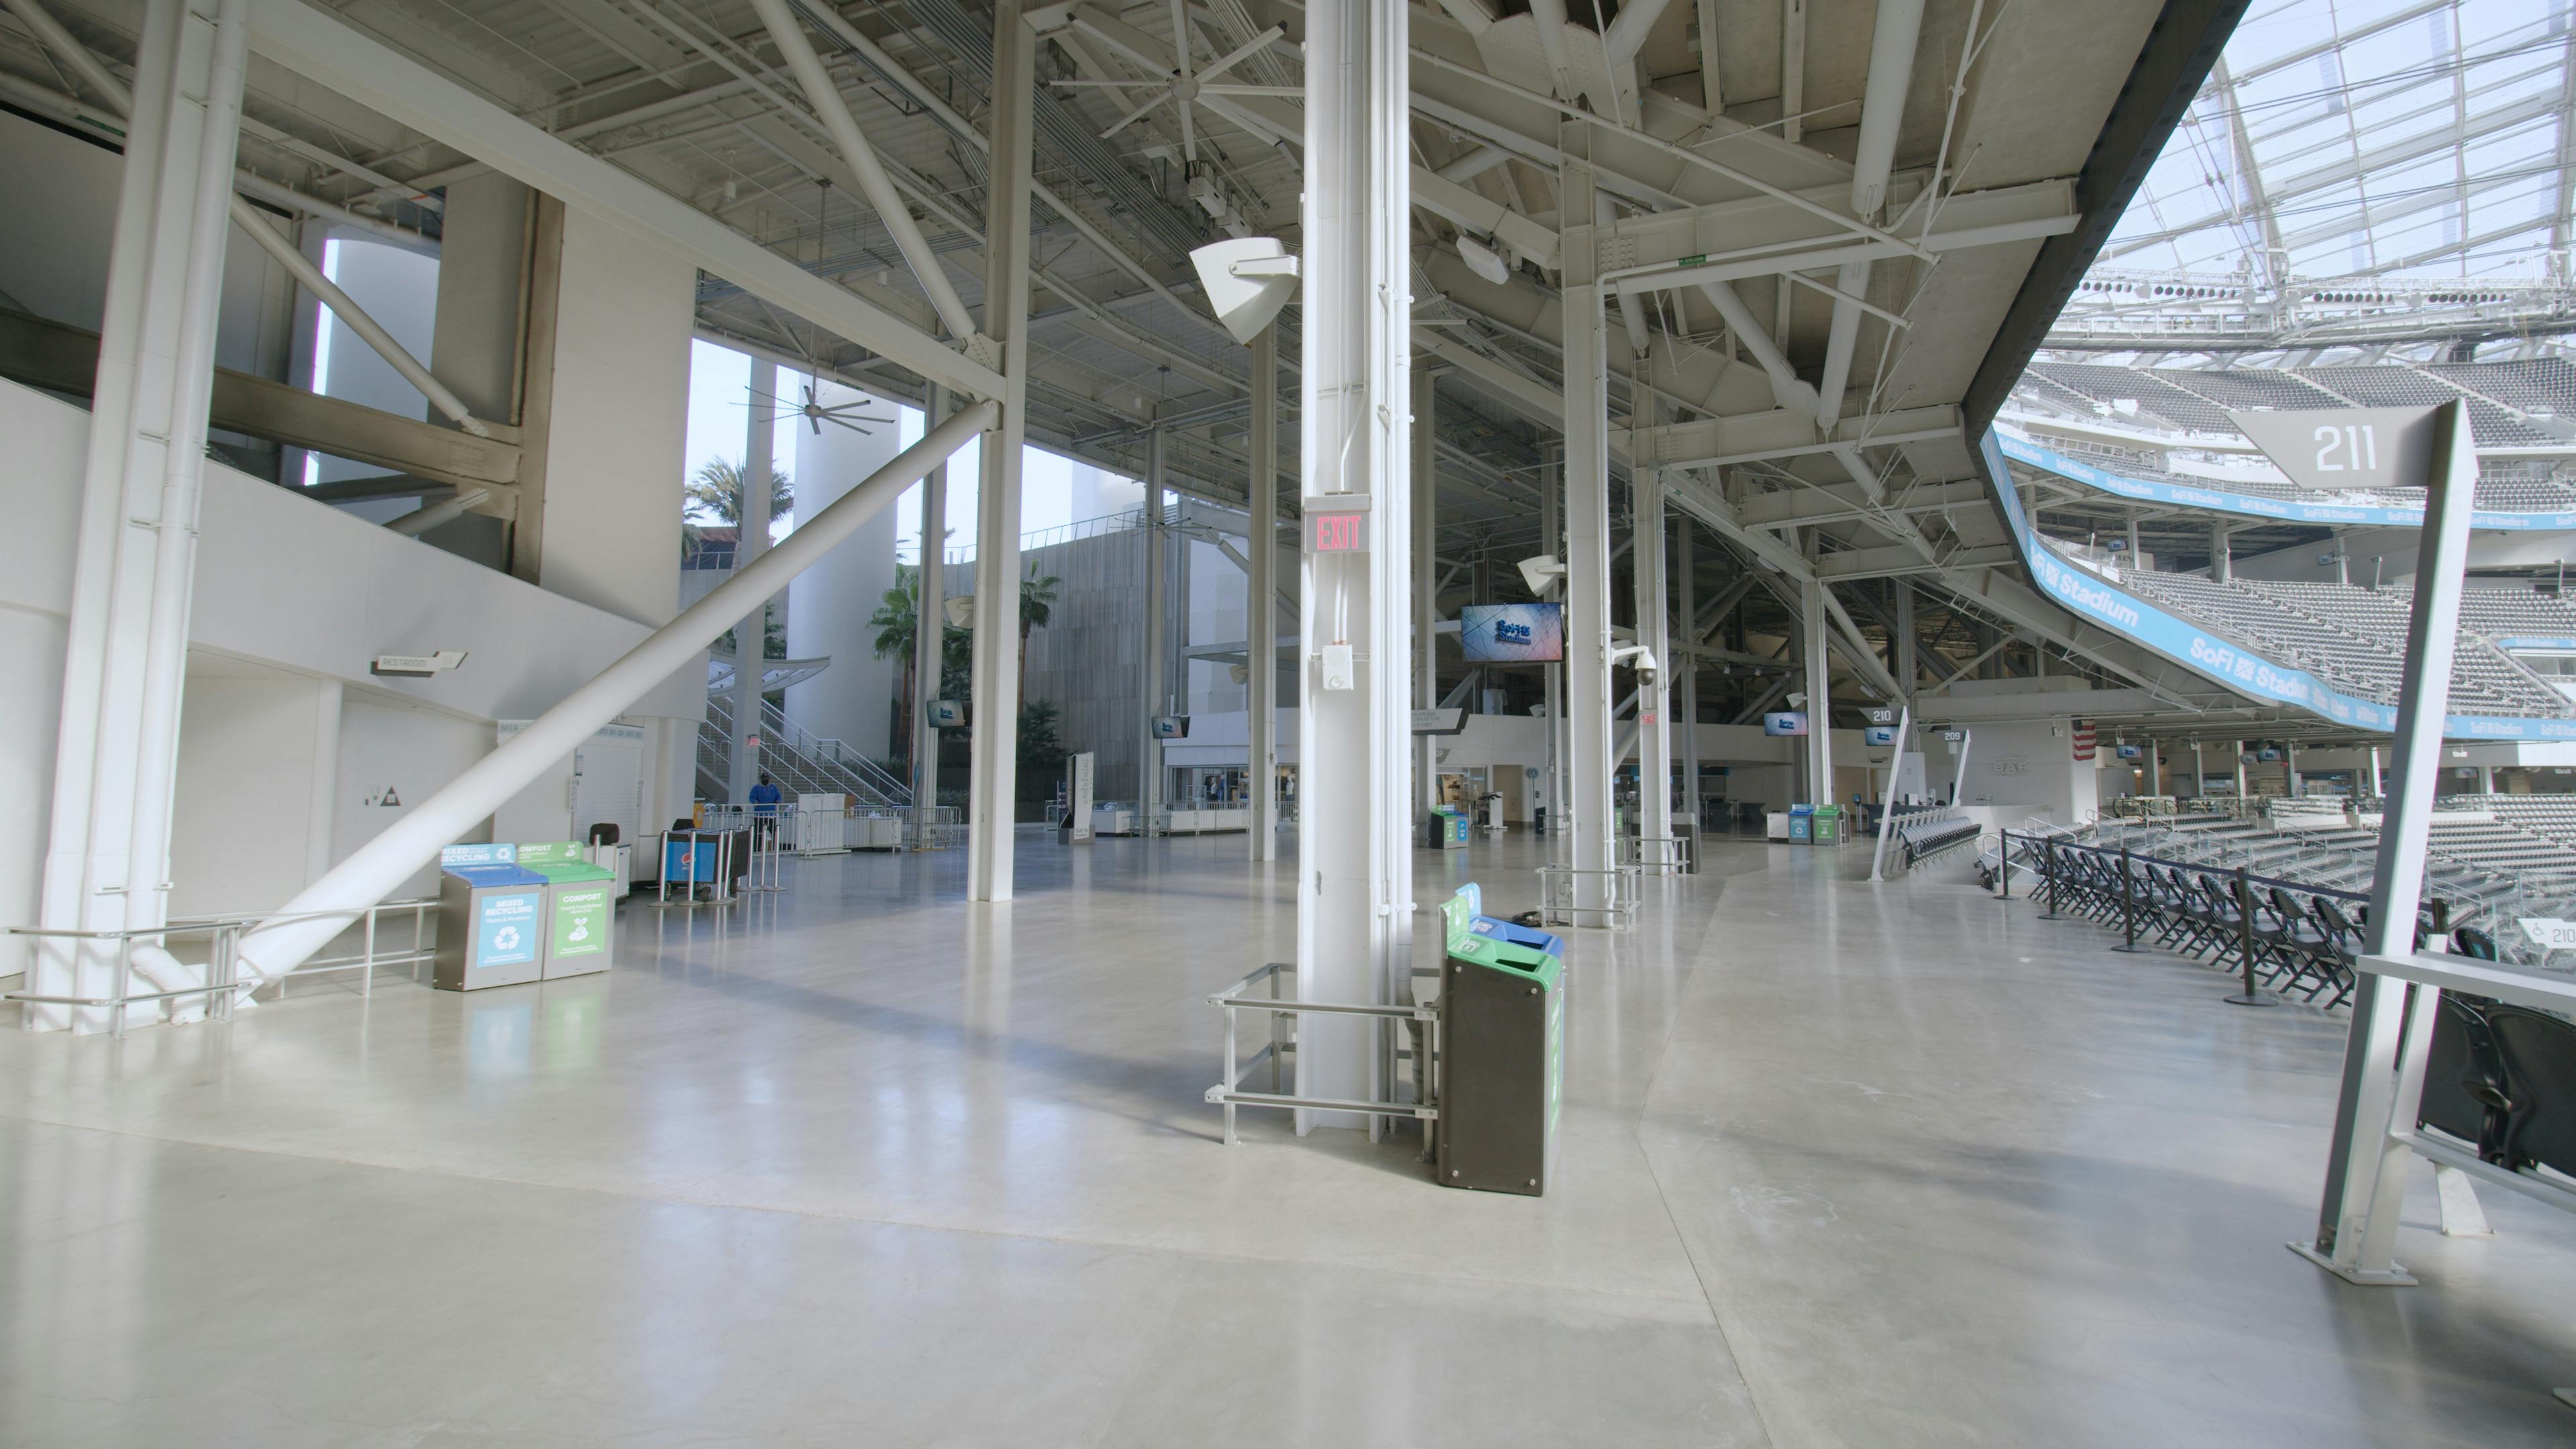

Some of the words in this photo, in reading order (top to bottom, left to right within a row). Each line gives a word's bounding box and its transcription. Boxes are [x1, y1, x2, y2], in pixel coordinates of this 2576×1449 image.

[2314, 425, 2376, 471] 211
[1317, 515, 1362, 550] EXIT
[2059, 572, 2139, 627] Stadium
[1499, 631, 1531, 645] Stadium
[2190, 637, 2235, 673] SoFi
[382, 658, 427, 667] RESTROOM
[1873, 710, 1891, 721] 210
[1944, 732, 1960, 740] 209
[1993, 762, 2030, 772] BAR
[496, 899, 524, 908] MIXED
[563, 893, 602, 903] COMPOST
[485, 906, 533, 916] RECYCLING
[2553, 928, 2576, 943] 210
